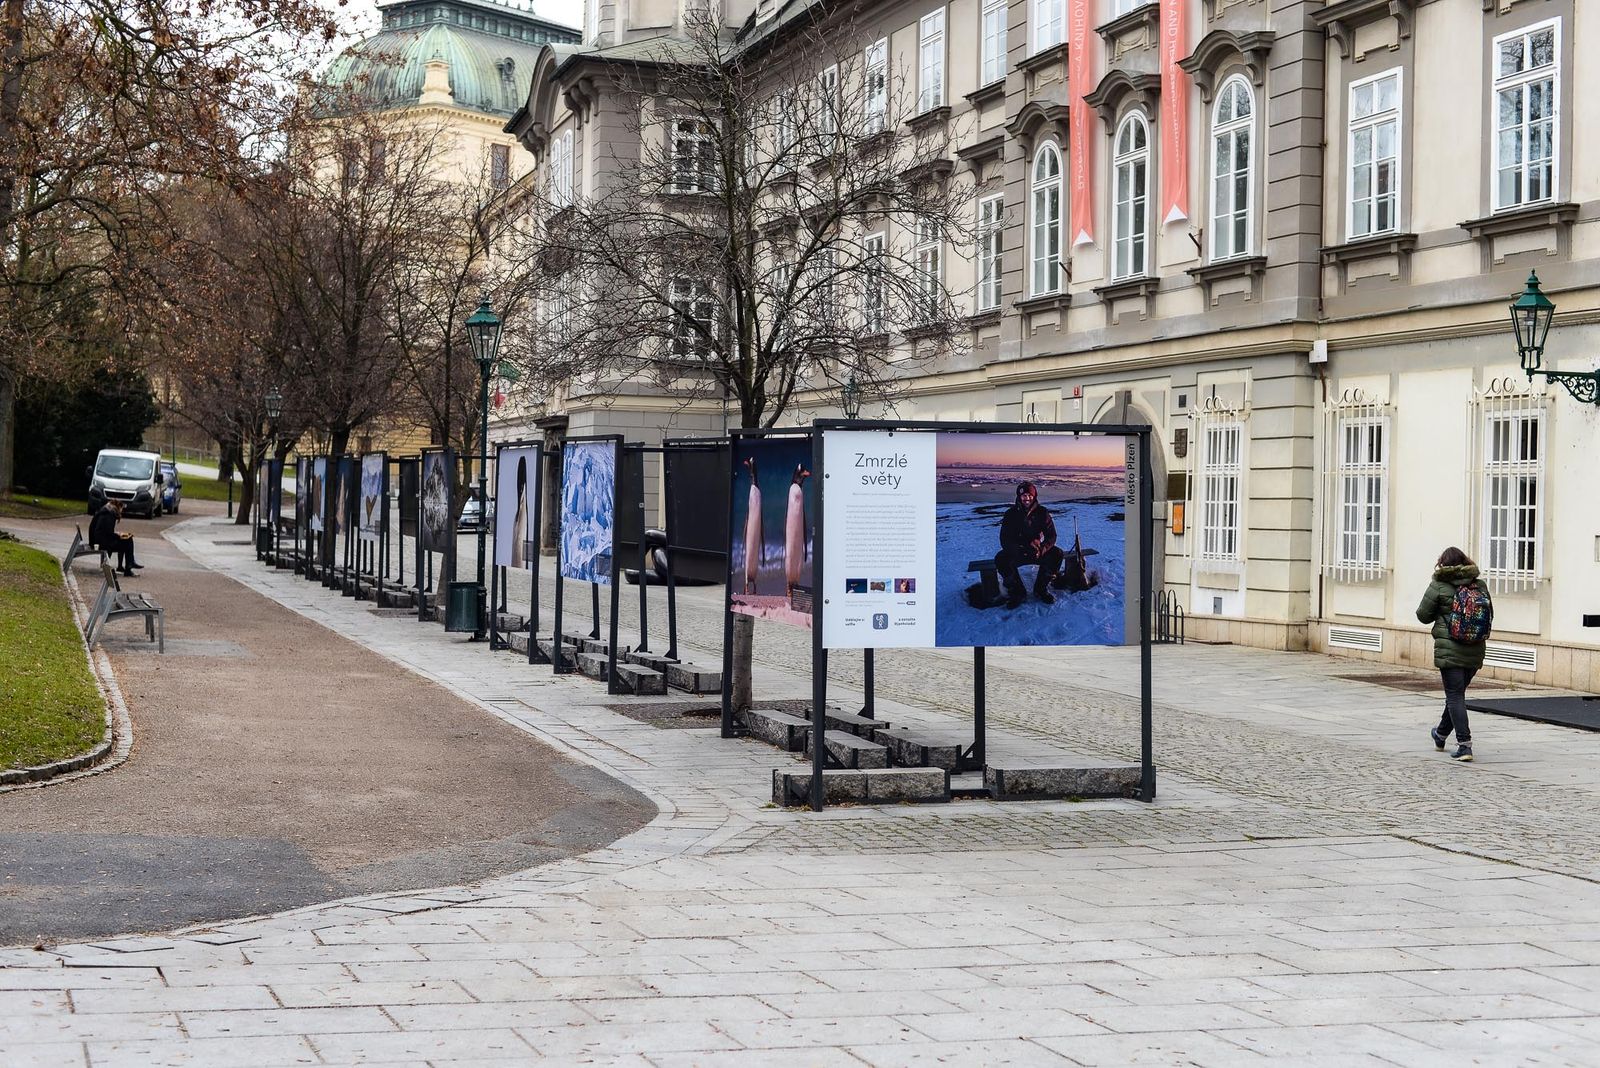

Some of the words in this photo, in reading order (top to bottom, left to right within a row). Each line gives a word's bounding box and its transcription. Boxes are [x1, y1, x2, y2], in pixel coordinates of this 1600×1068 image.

[1168, 9, 1177, 36] AND
[855, 452, 908, 468] Zmrzlé
[1127, 443, 1136, 470] Plzeň
[861, 471, 902, 490] světy
[1127, 472, 1136, 505] Město
